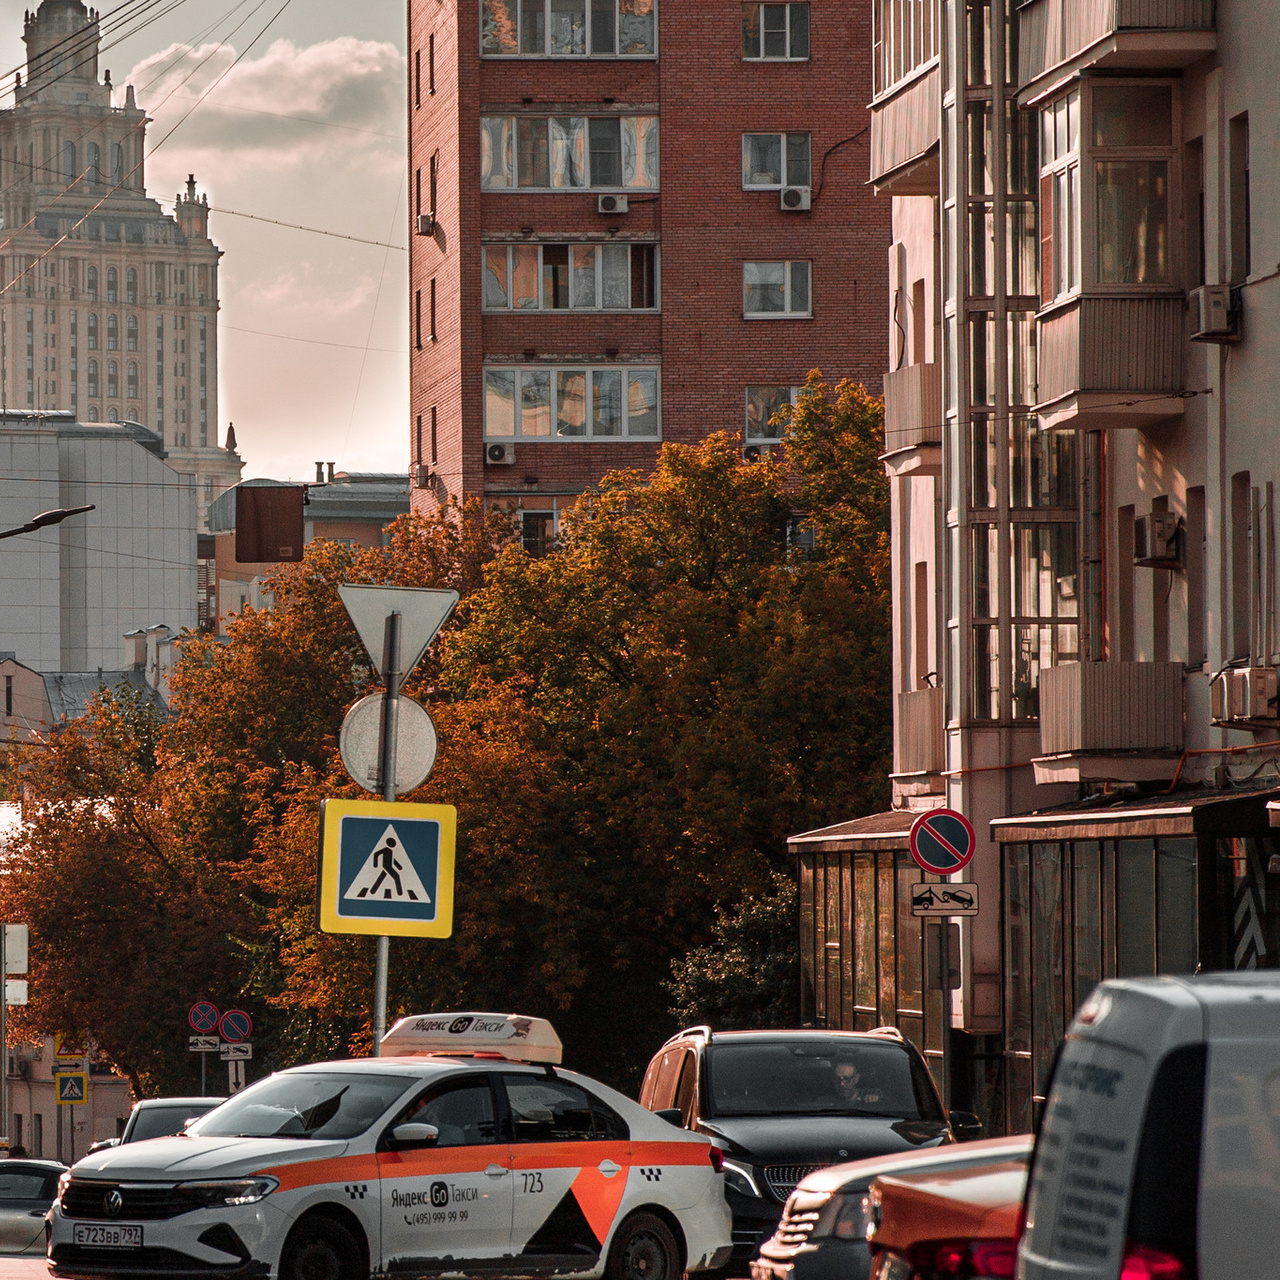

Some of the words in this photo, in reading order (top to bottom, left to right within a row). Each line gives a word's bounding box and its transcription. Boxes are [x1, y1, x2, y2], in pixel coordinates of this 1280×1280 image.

[411, 1019, 450, 1032] Яндекс
[451, 1018, 469, 1032] Go
[471, 1019, 505, 1032] Такси
[521, 1172, 544, 1193] 723
[391, 1188, 428, 1208] Яндекс
[431, 1184, 447, 1205] Go
[450, 1184, 478, 1203] Такси
[412, 1213, 431, 1226] (495)
[432, 1211, 446, 1223] 999
[448, 1211, 457, 1223] 99
[459, 1210, 469, 1221] 99
[78, 1227, 119, 1244] Е723ВВ
[121, 1228, 138, 1240] 797
